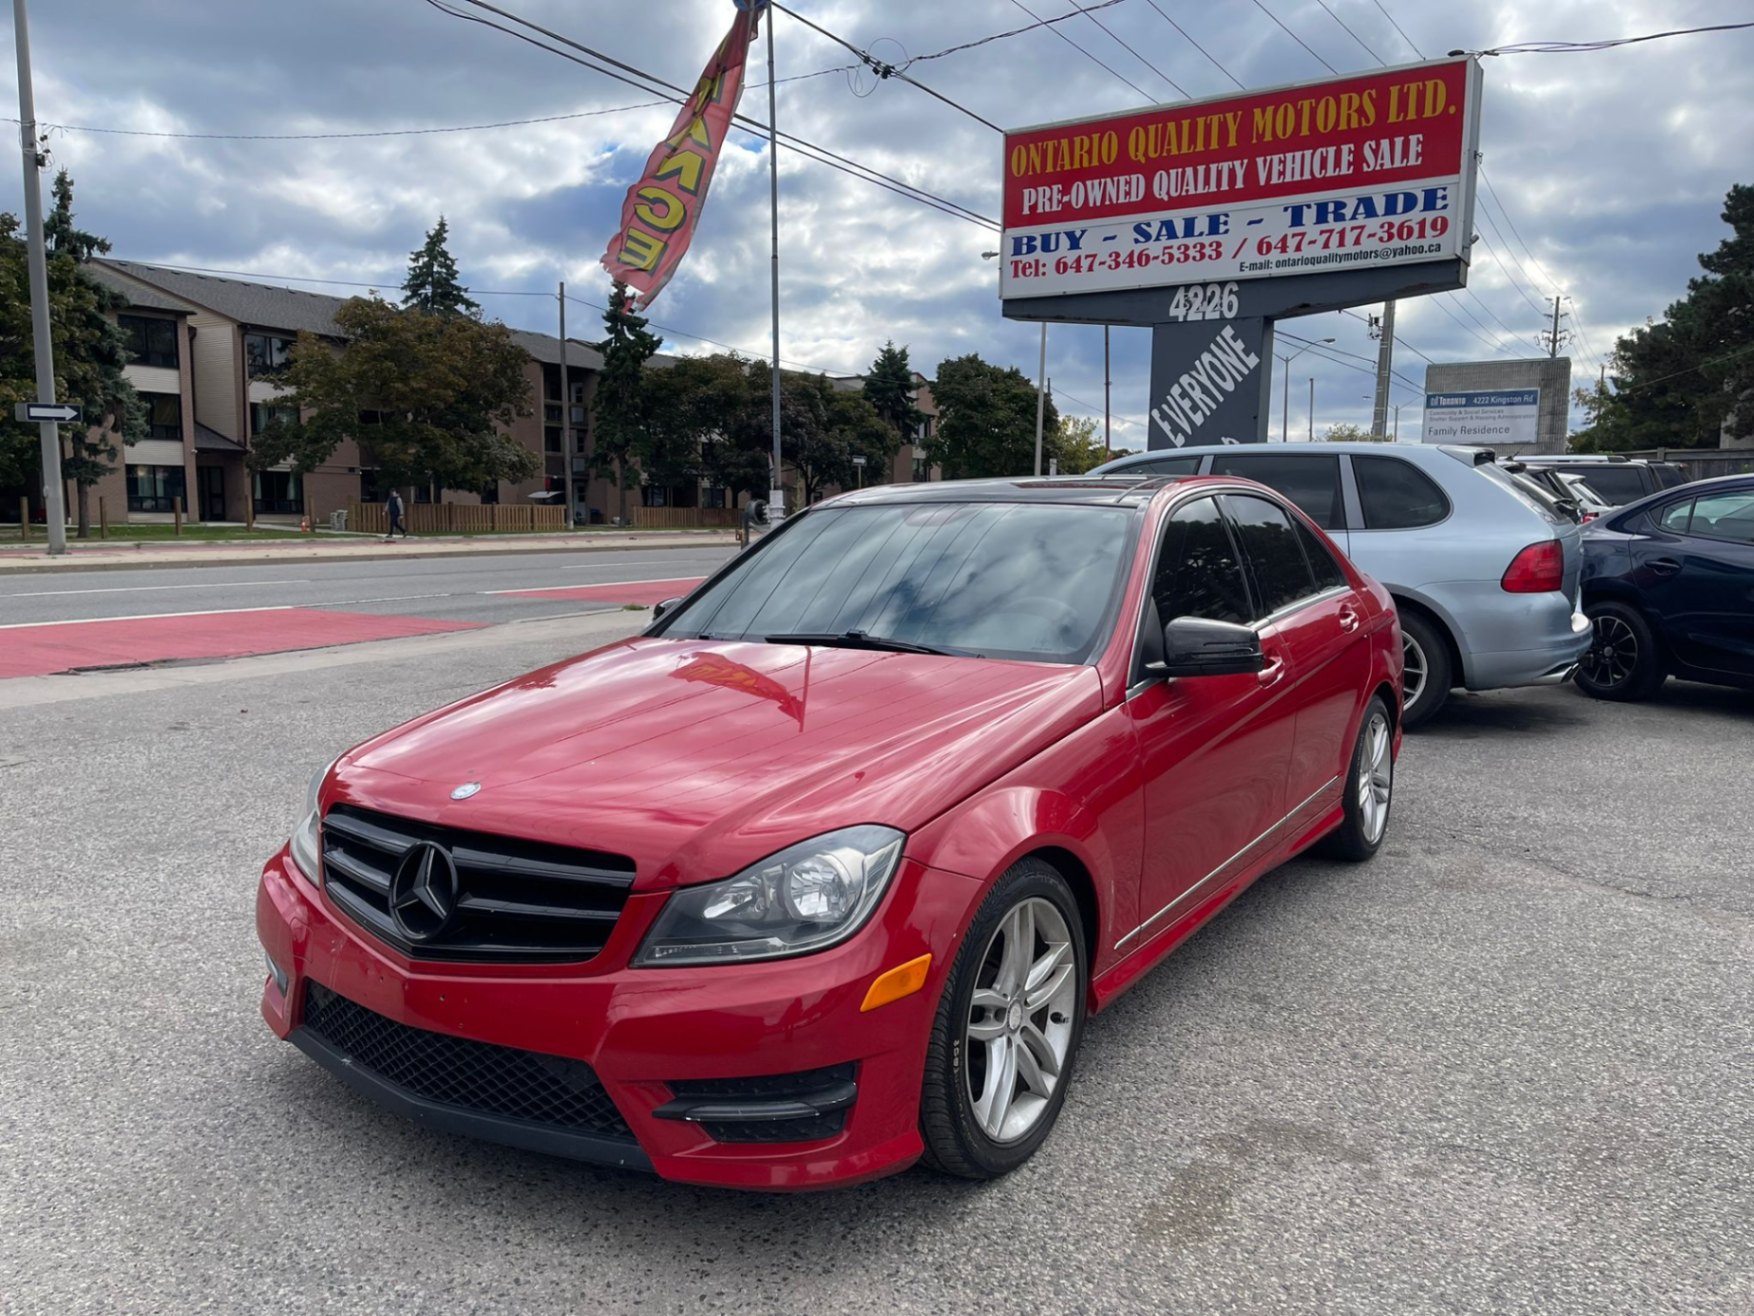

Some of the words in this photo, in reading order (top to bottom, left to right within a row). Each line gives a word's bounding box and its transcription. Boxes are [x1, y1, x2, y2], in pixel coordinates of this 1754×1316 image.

[1011, 130, 1119, 178] ONTARIO
[1128, 111, 1243, 164] QUALITY
[1251, 88, 1377, 144] MOTORS
[1387, 79, 1456, 124] LTD.
[1022, 173, 1146, 215] PRE-OWNED
[1152, 159, 1249, 201] QUALITY
[1256, 144, 1355, 186] VEHICLE
[1362, 134, 1424, 172] SALE
[1010, 259, 1047, 279] Tel:
[1054, 240, 1223, 275] 647-346-5333
[1231, 238, 1248, 259] /
[1256, 215, 1449, 256] 647-717-3619
[1011, 229, 1088, 257] BUY
[1133, 213, 1230, 244] SALE
[1283, 186, 1449, 228] TRADE
[1239, 260, 1273, 272] E-mail:
[1275, 242, 1441, 269] ontarioqualitymotors@yahoo.ca
[1169, 281, 1239, 322] 4226
[1151, 324, 1260, 448] EVERYONE
[1472, 396, 1489, 405] 4222
[1490, 395, 1522, 405] Kingston
[1523, 394, 1534, 403] Rd
[1428, 426, 1458, 437] Family
[1460, 425, 1510, 435] Residence
